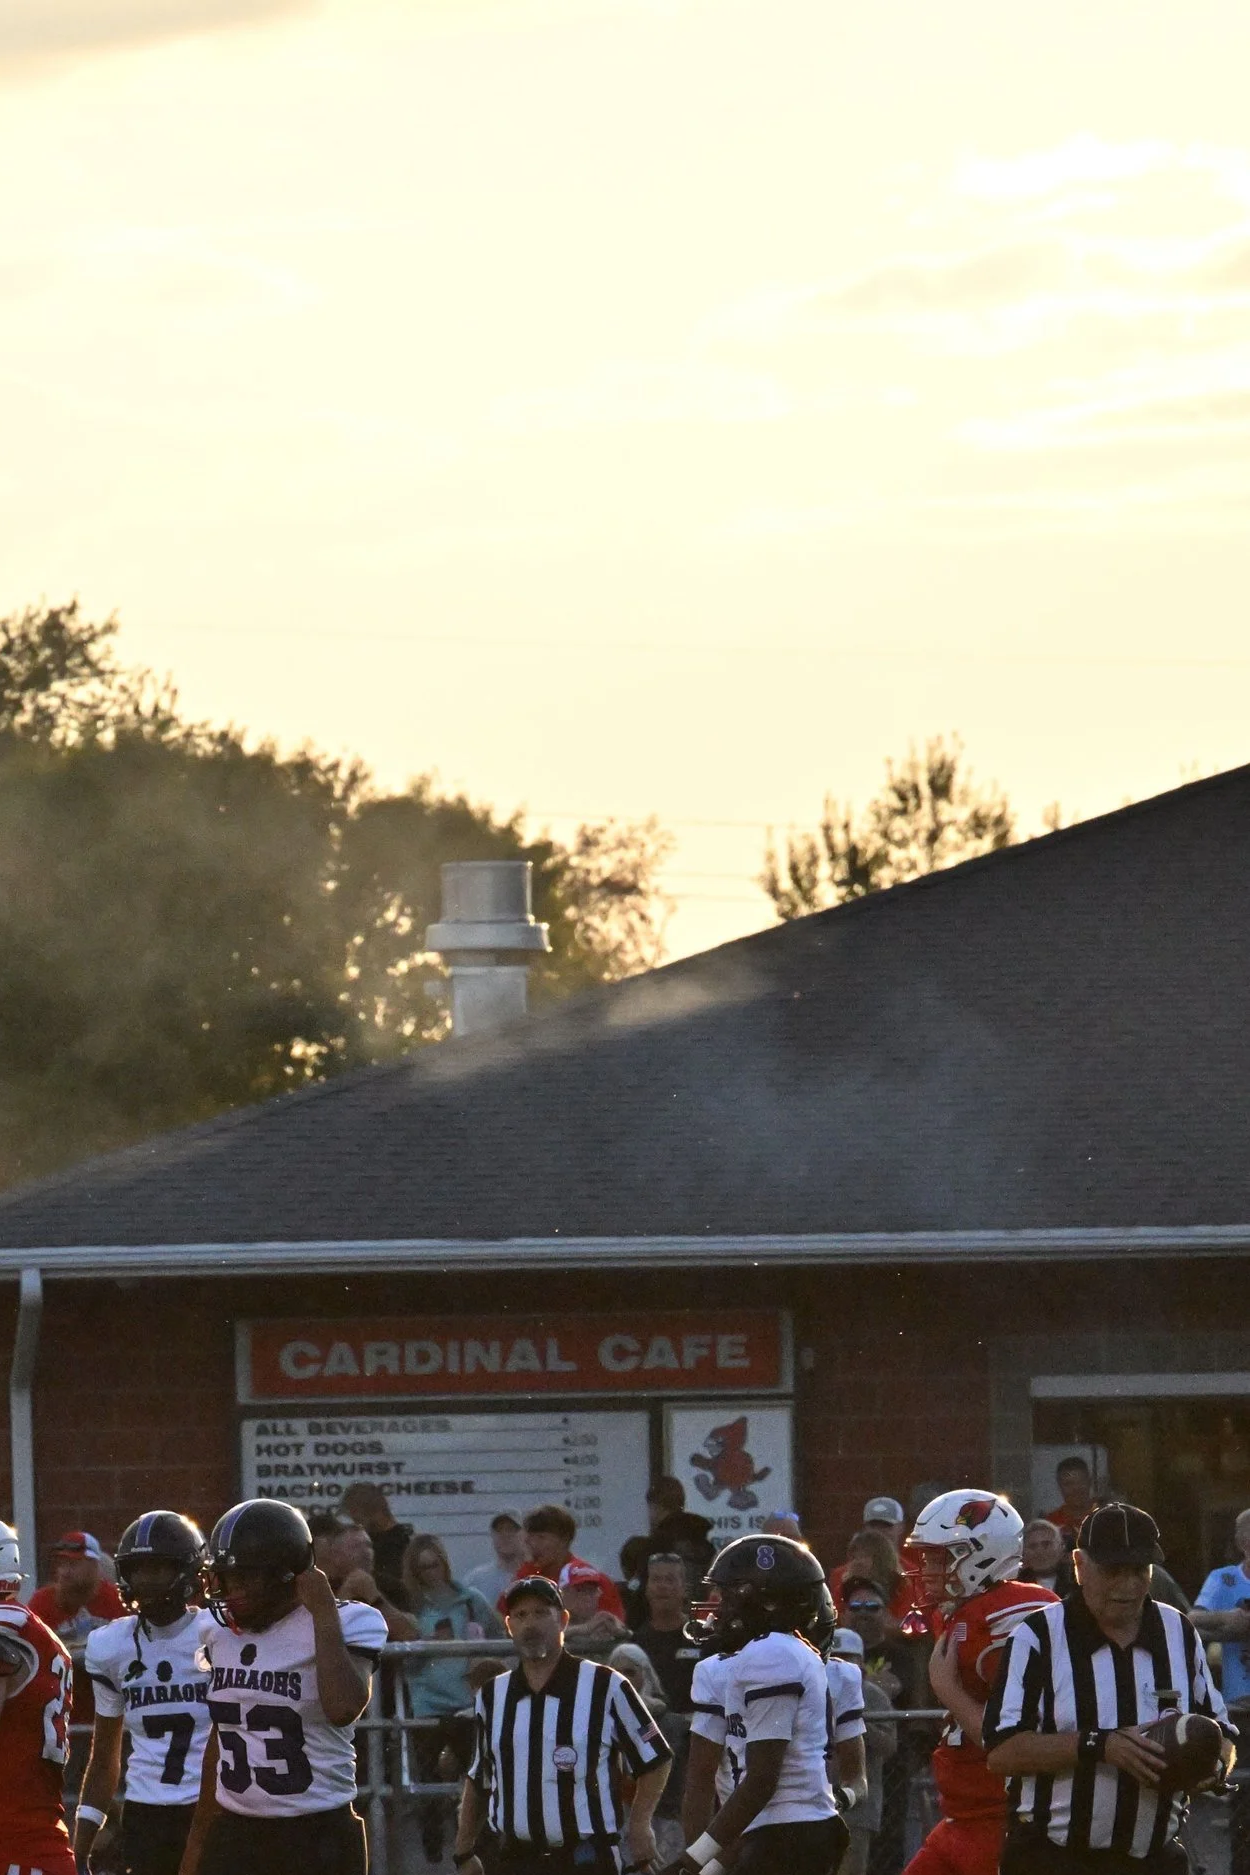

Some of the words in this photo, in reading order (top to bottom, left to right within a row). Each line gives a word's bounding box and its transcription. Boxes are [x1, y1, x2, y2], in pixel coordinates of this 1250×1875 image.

[278, 1337, 577, 1379] CARDINAL
[597, 1334, 751, 1372] CAFE
[255, 1422, 297, 1436] ALL
[307, 1419, 453, 1436] BEVERAGES
[255, 1442, 304, 1457] HOT
[313, 1440, 384, 1456] DOGS
[256, 1461, 406, 1477] BRATWURST
[257, 1483, 343, 1498] NACHO
[756, 1545, 775, 1570] 8
[142, 1712, 196, 1785] 7
[209, 1701, 314, 1795] 53
